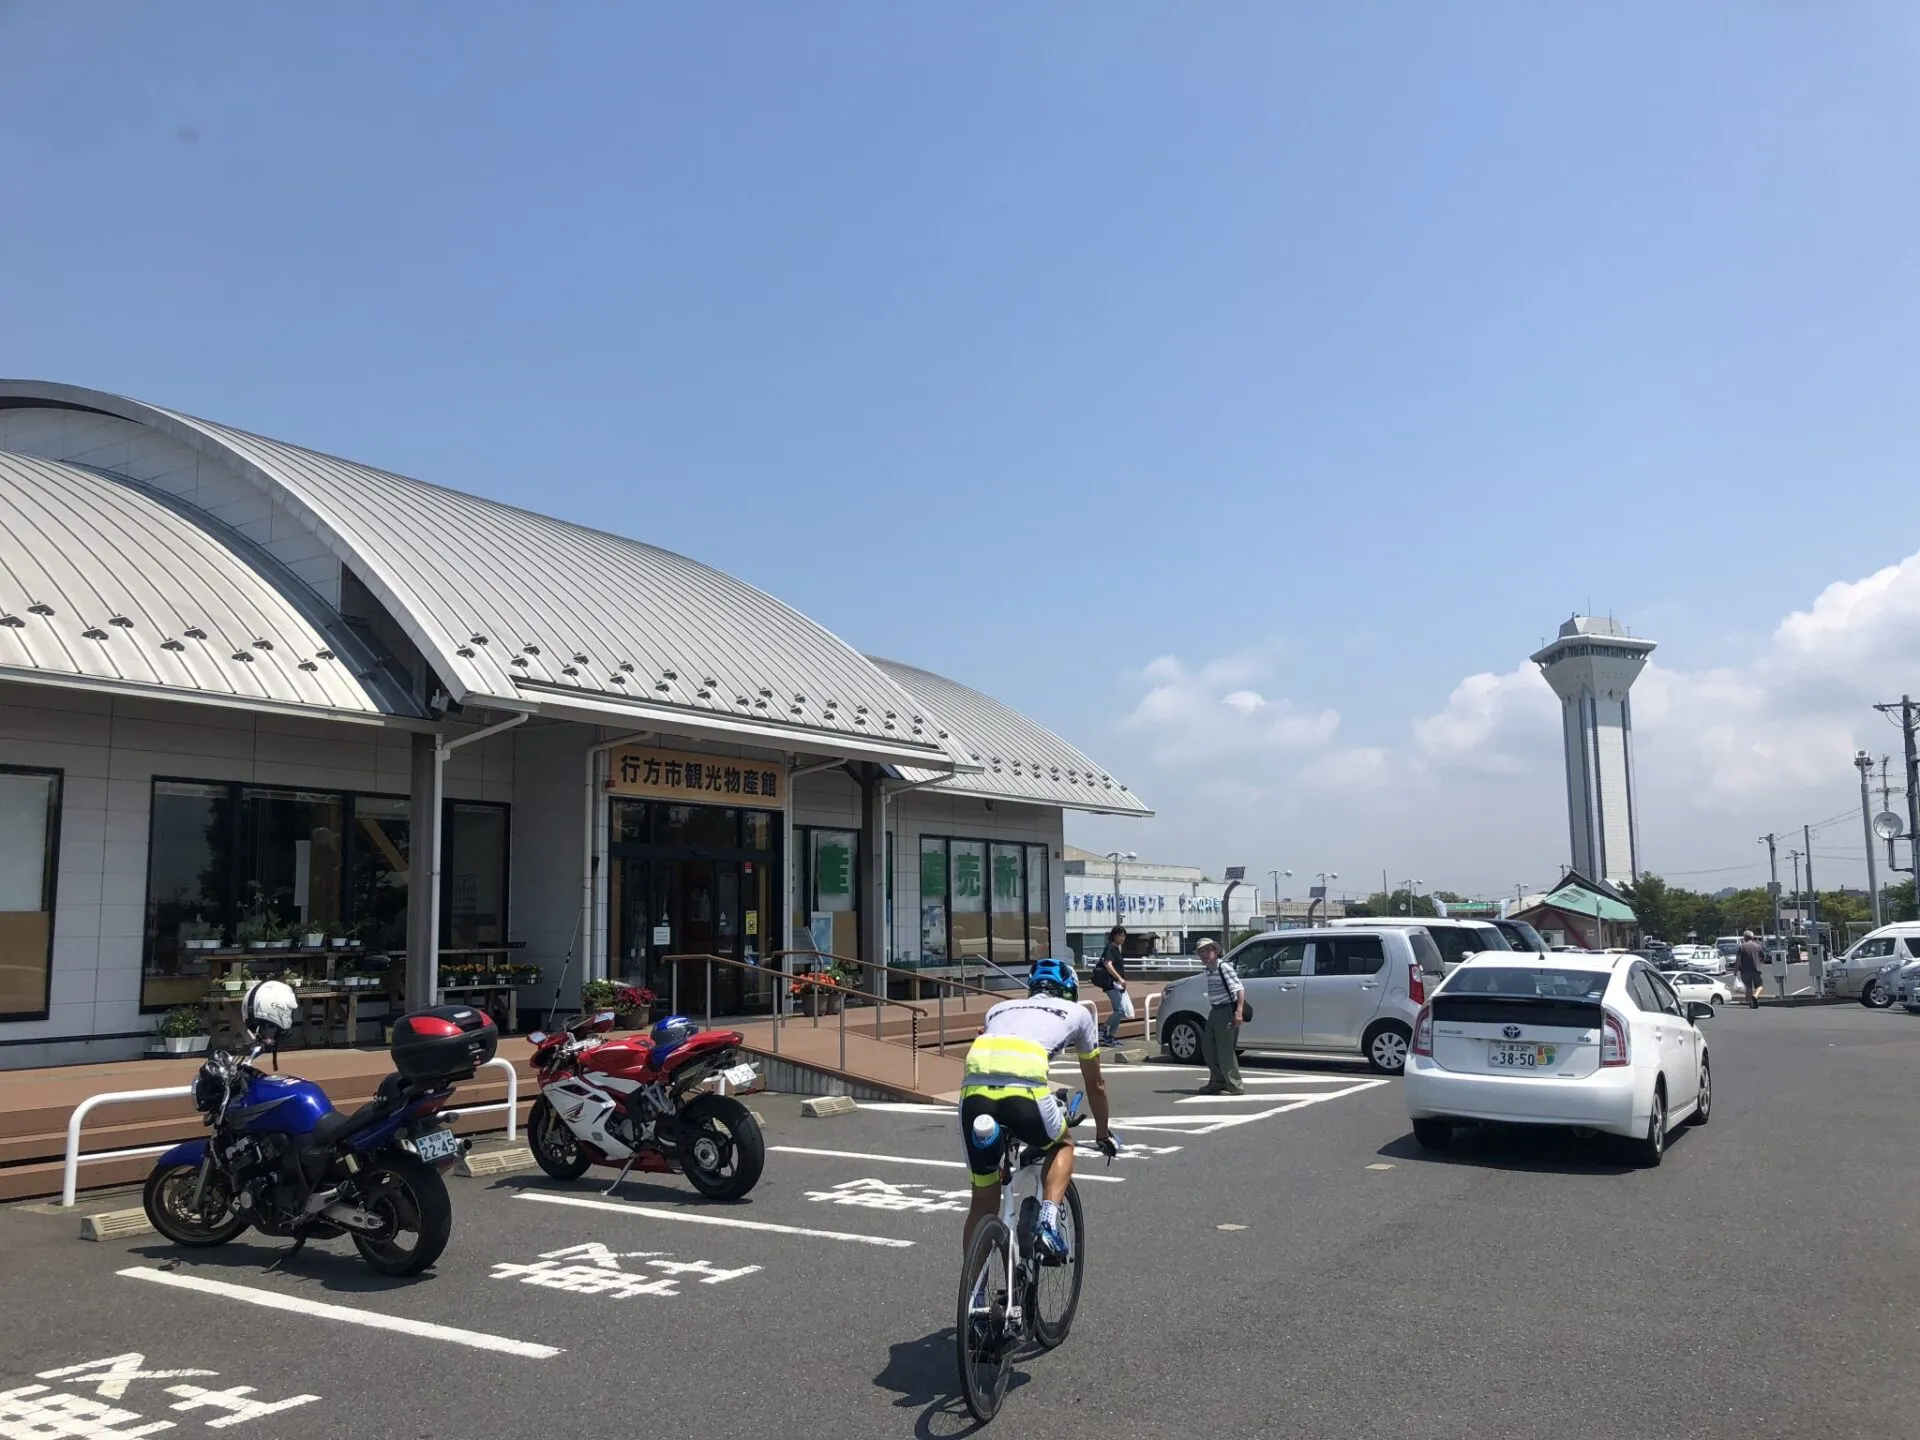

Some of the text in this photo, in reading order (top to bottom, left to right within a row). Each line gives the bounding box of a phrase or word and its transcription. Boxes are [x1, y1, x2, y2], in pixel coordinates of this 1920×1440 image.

[620, 754, 777, 798] 行方市観光物産館
[1499, 1052, 1535, 1066] 38-50
[421, 1138, 456, 1160] 22-45
